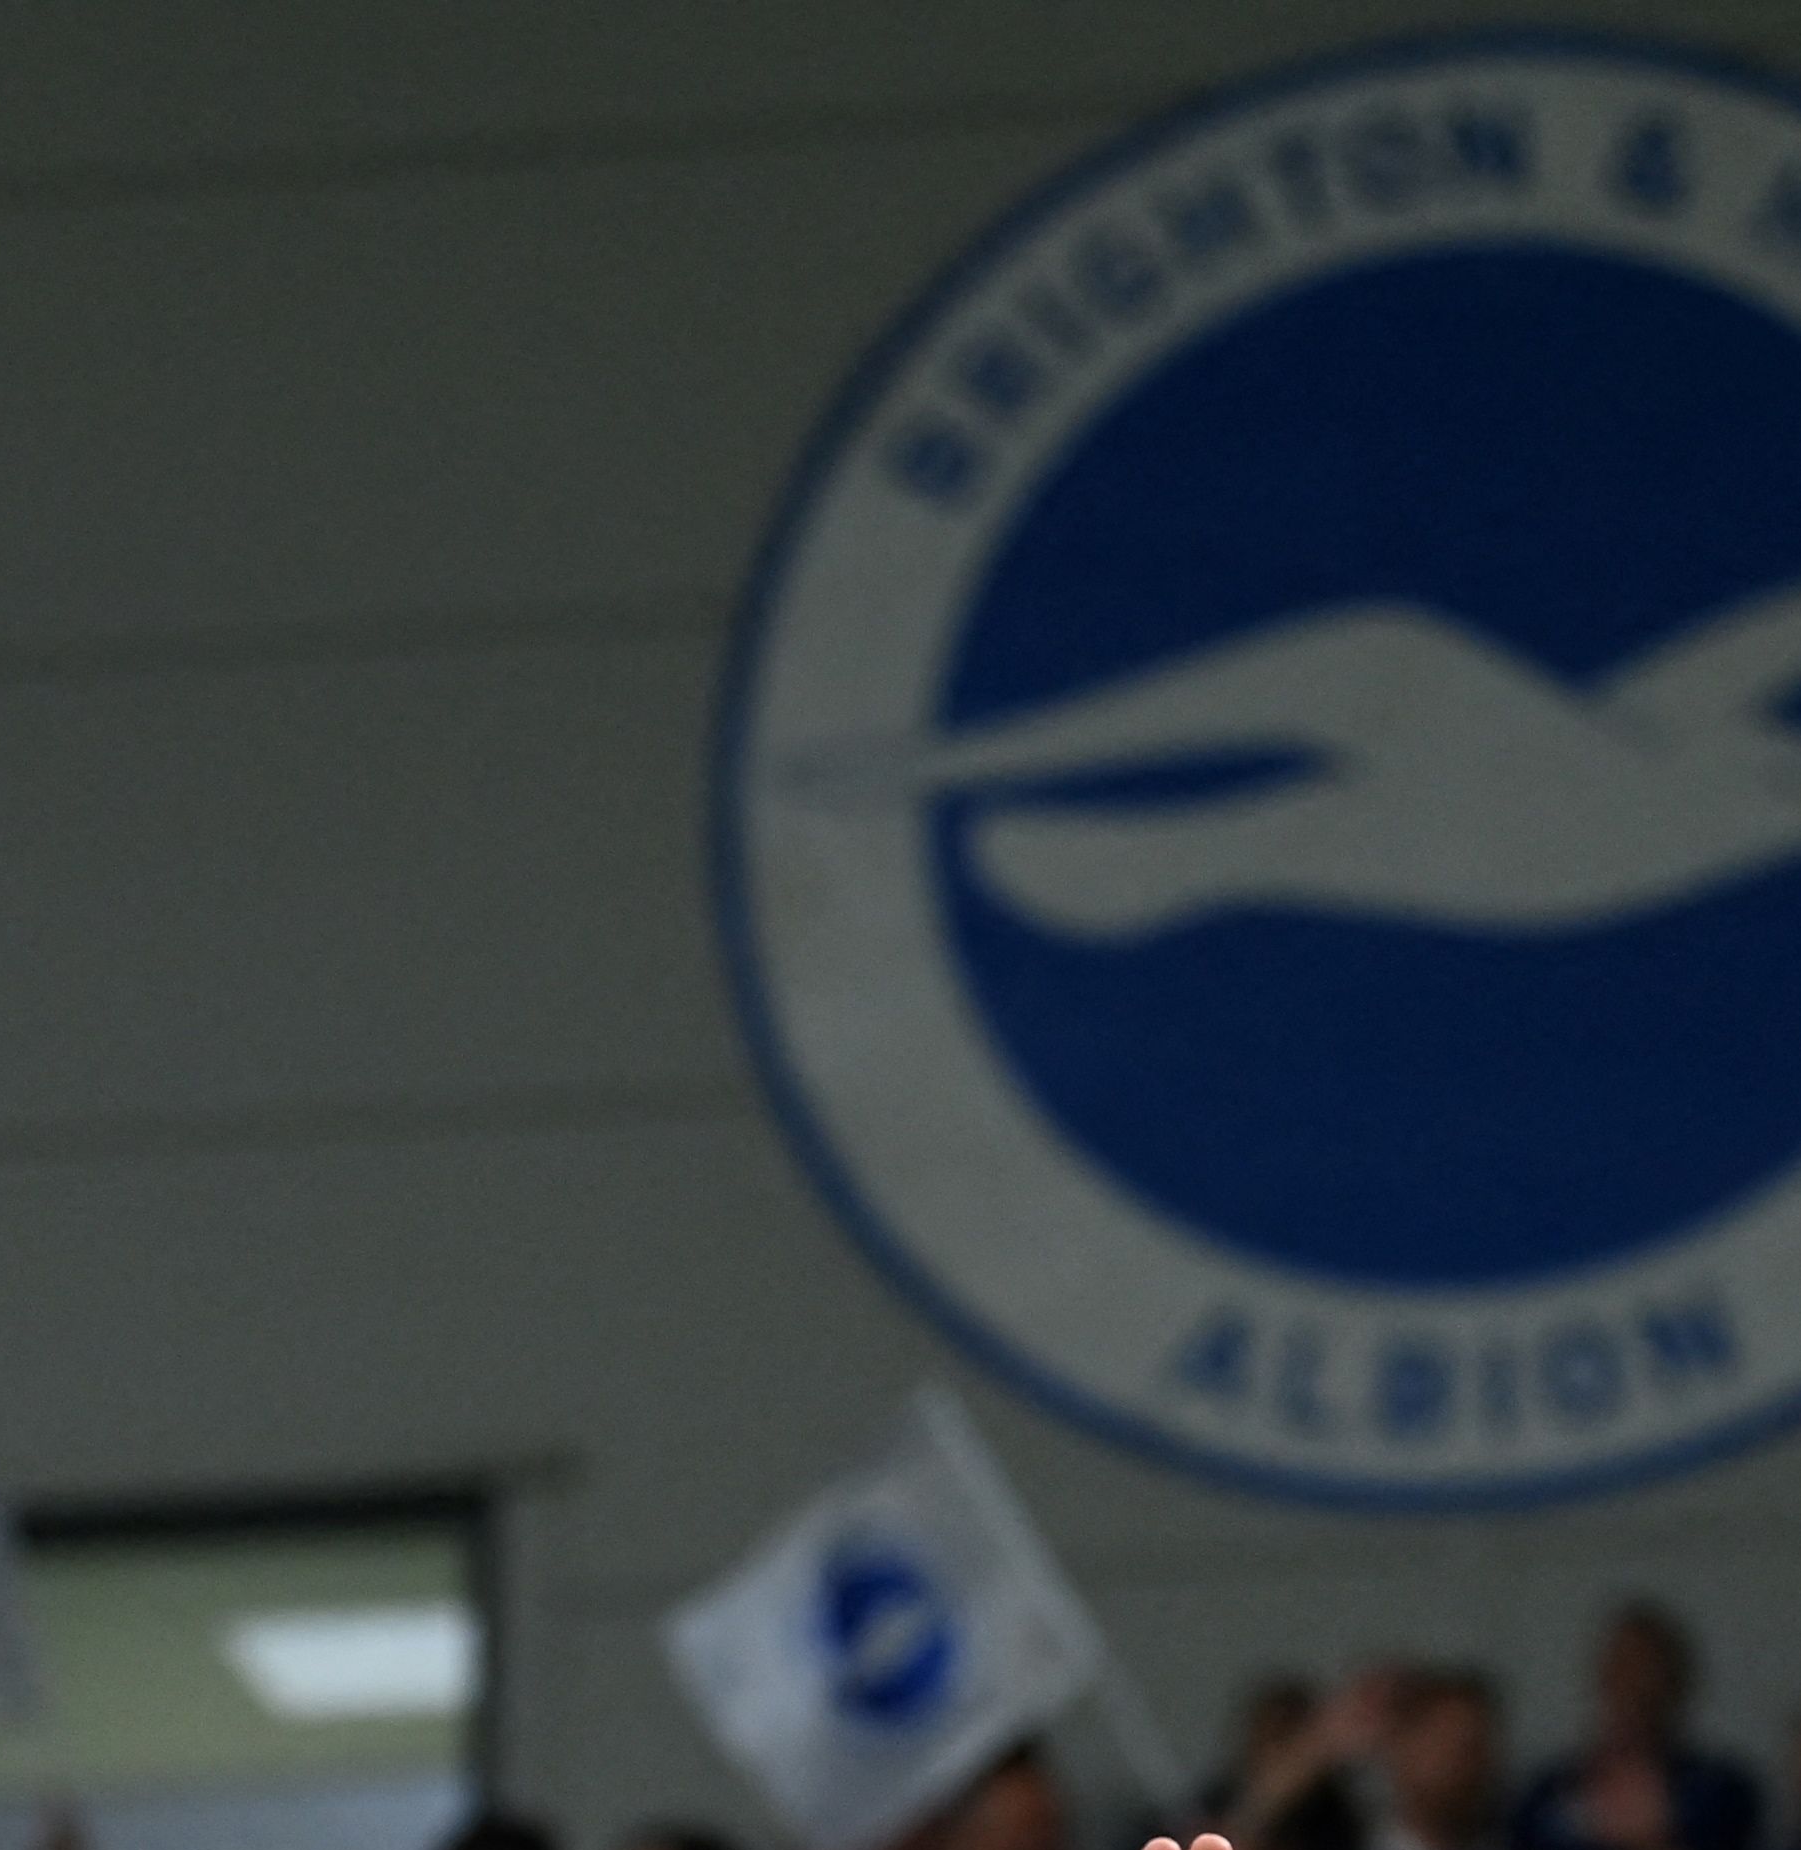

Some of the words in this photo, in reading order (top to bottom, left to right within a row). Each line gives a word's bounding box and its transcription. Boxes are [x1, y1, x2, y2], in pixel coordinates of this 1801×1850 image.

[885, 102, 1533, 511] BRIGHTON
[1617, 104, 1693, 216] &
[1171, 1280, 1741, 1444] ALBION
